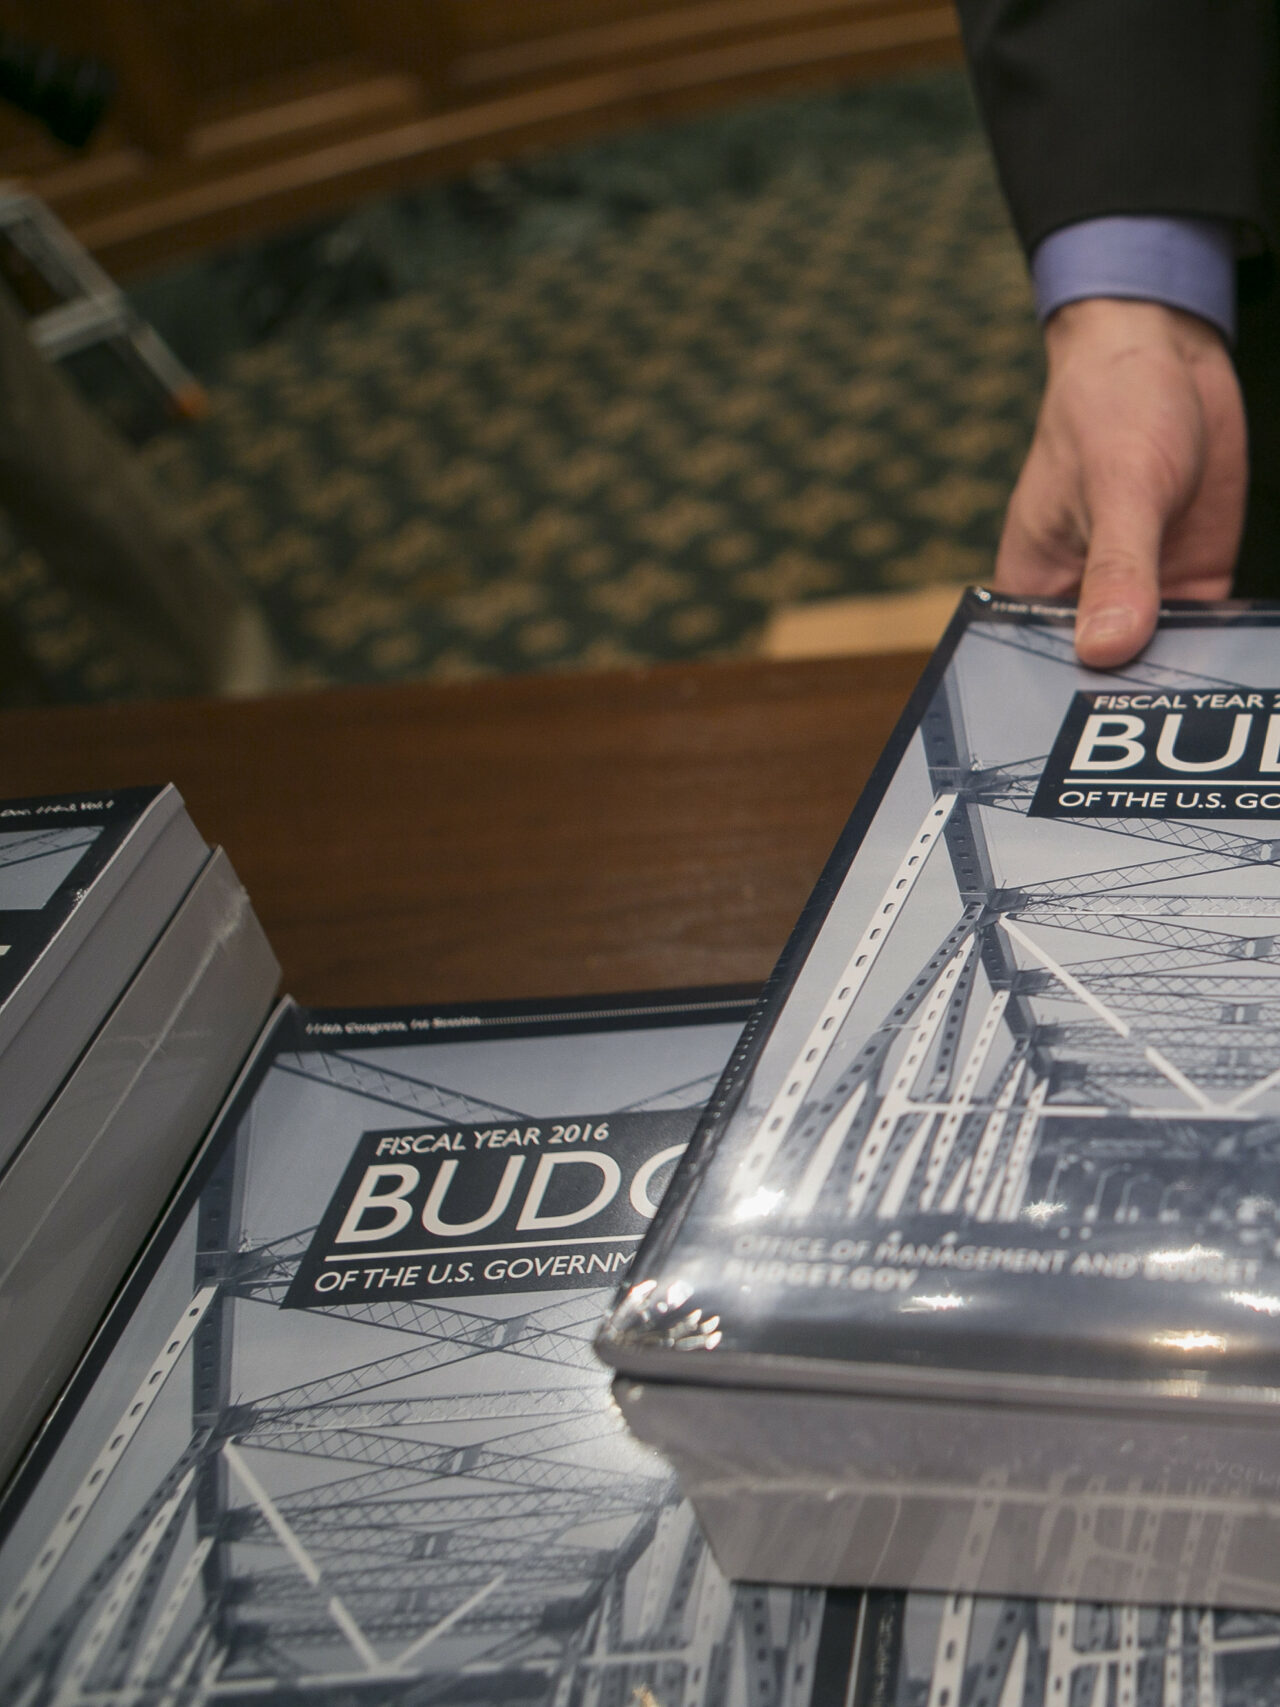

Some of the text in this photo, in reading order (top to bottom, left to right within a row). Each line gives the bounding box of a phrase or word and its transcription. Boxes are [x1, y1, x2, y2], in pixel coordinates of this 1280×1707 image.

[1093, 694, 1187, 710] FISCAL
[1192, 694, 1264, 709] YEAR
[1058, 790, 1102, 808] OF
[1107, 791, 1168, 808] THE
[1176, 792, 1227, 809] U.S.
[376, 1122, 610, 1157] FISCAL YEAR 2016
[334, 1141, 686, 1244] BUD
[314, 1250, 637, 1293] OF THE U.S. GOVERNM
[1070, 1251, 1139, 1280] AND
